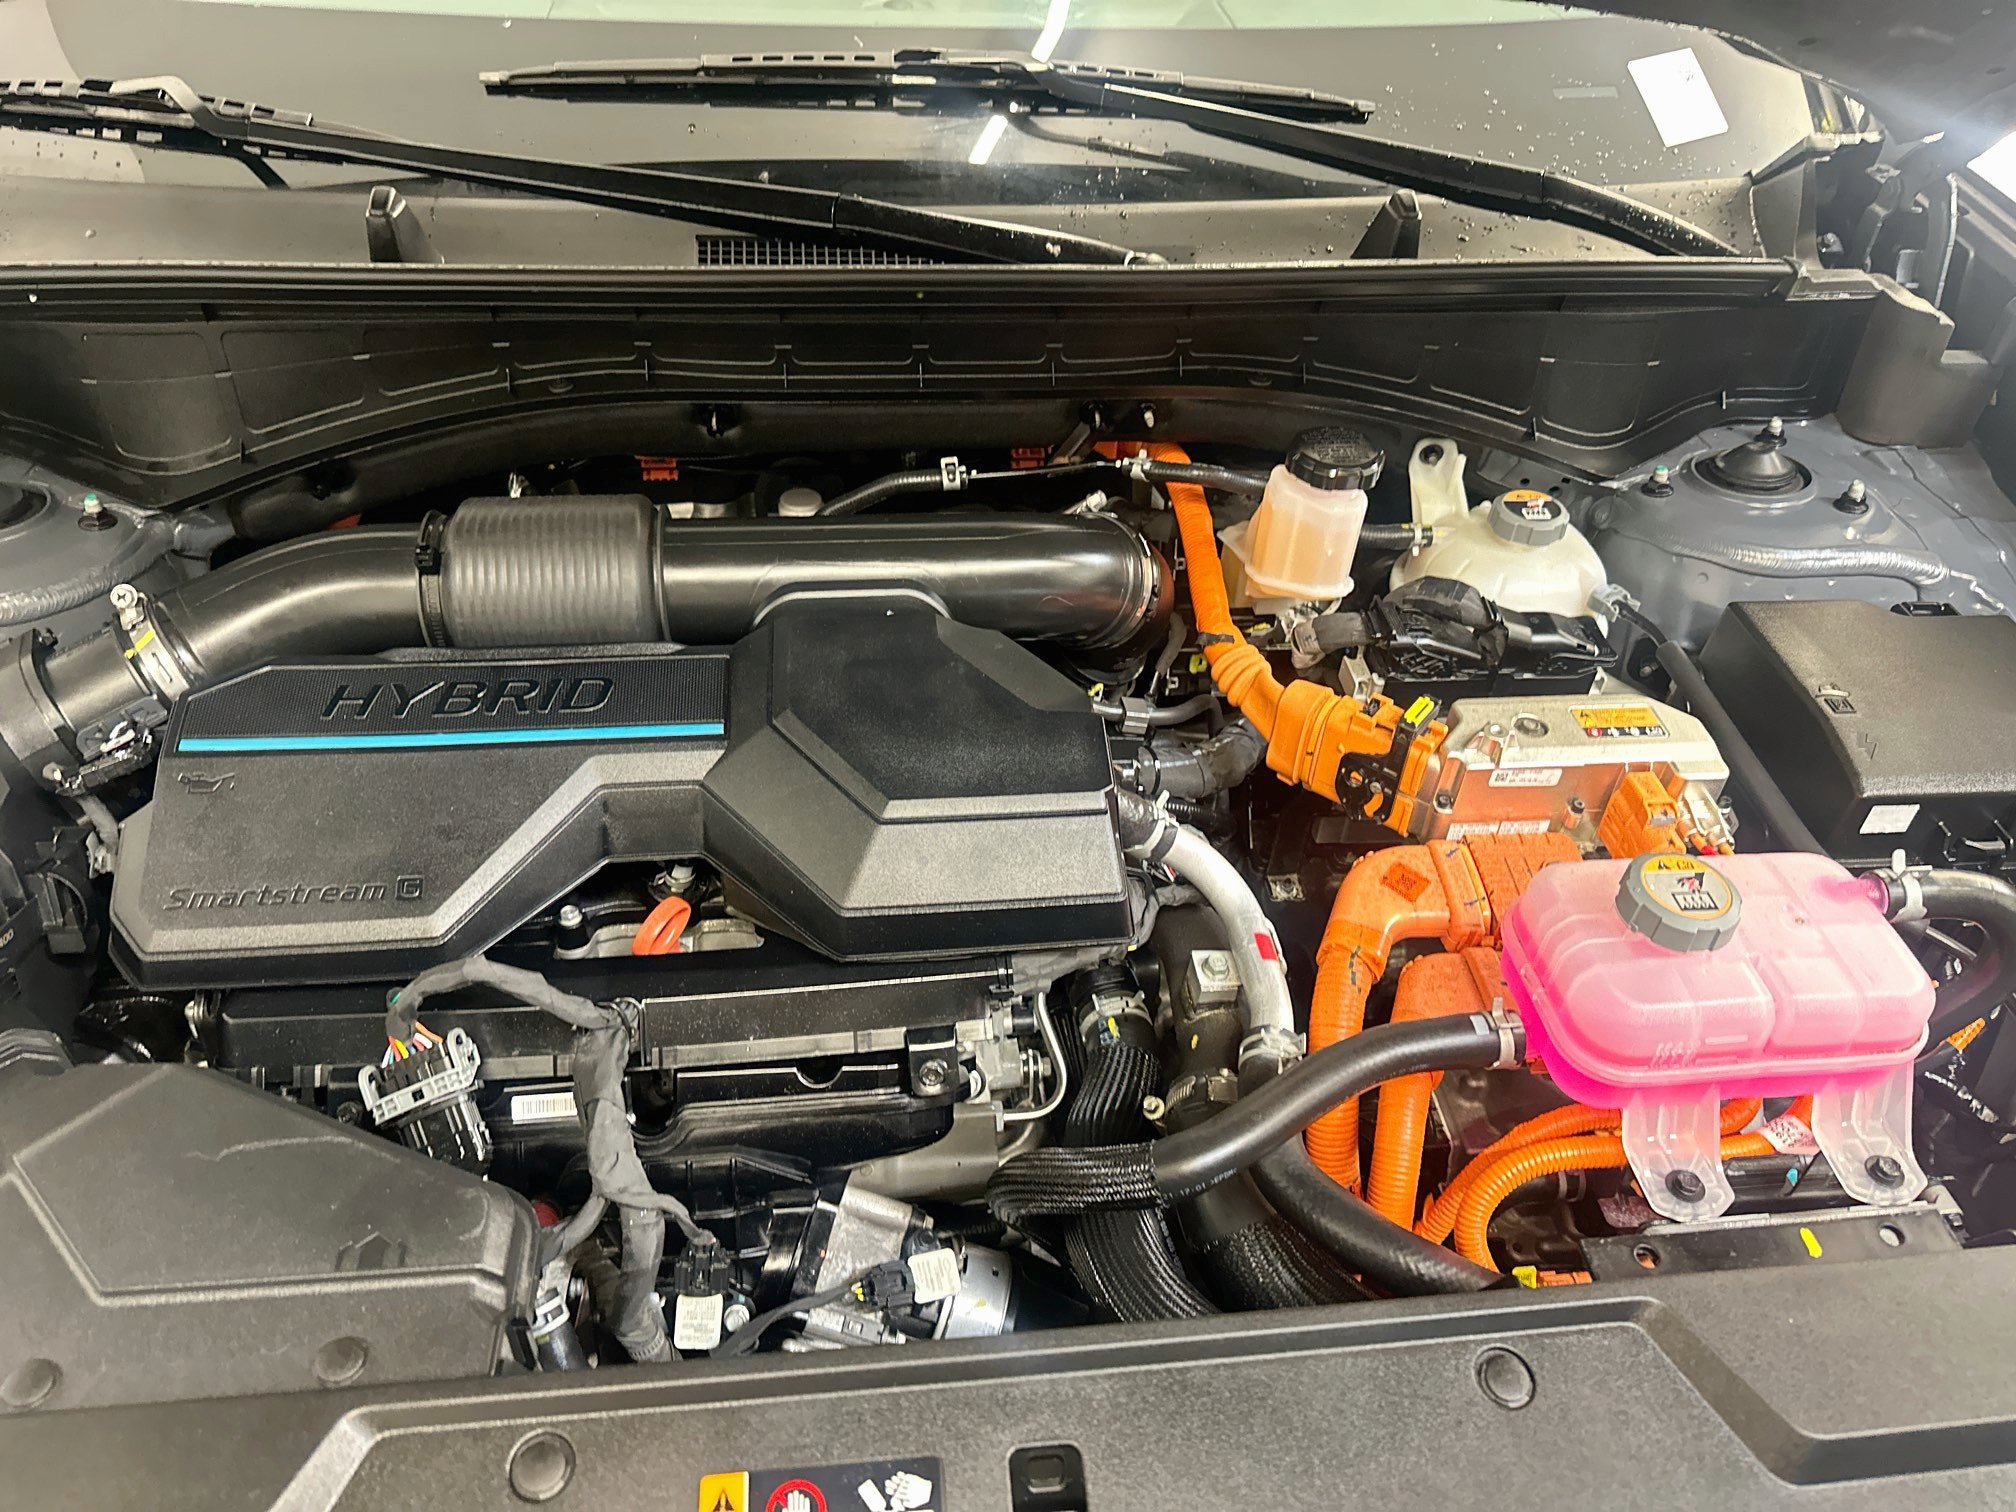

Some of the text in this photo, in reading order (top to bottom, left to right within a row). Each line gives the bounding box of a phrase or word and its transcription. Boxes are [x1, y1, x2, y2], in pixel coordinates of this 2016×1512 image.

[320, 677, 614, 720] HYBRID
[163, 876, 423, 910] Smartstream G
